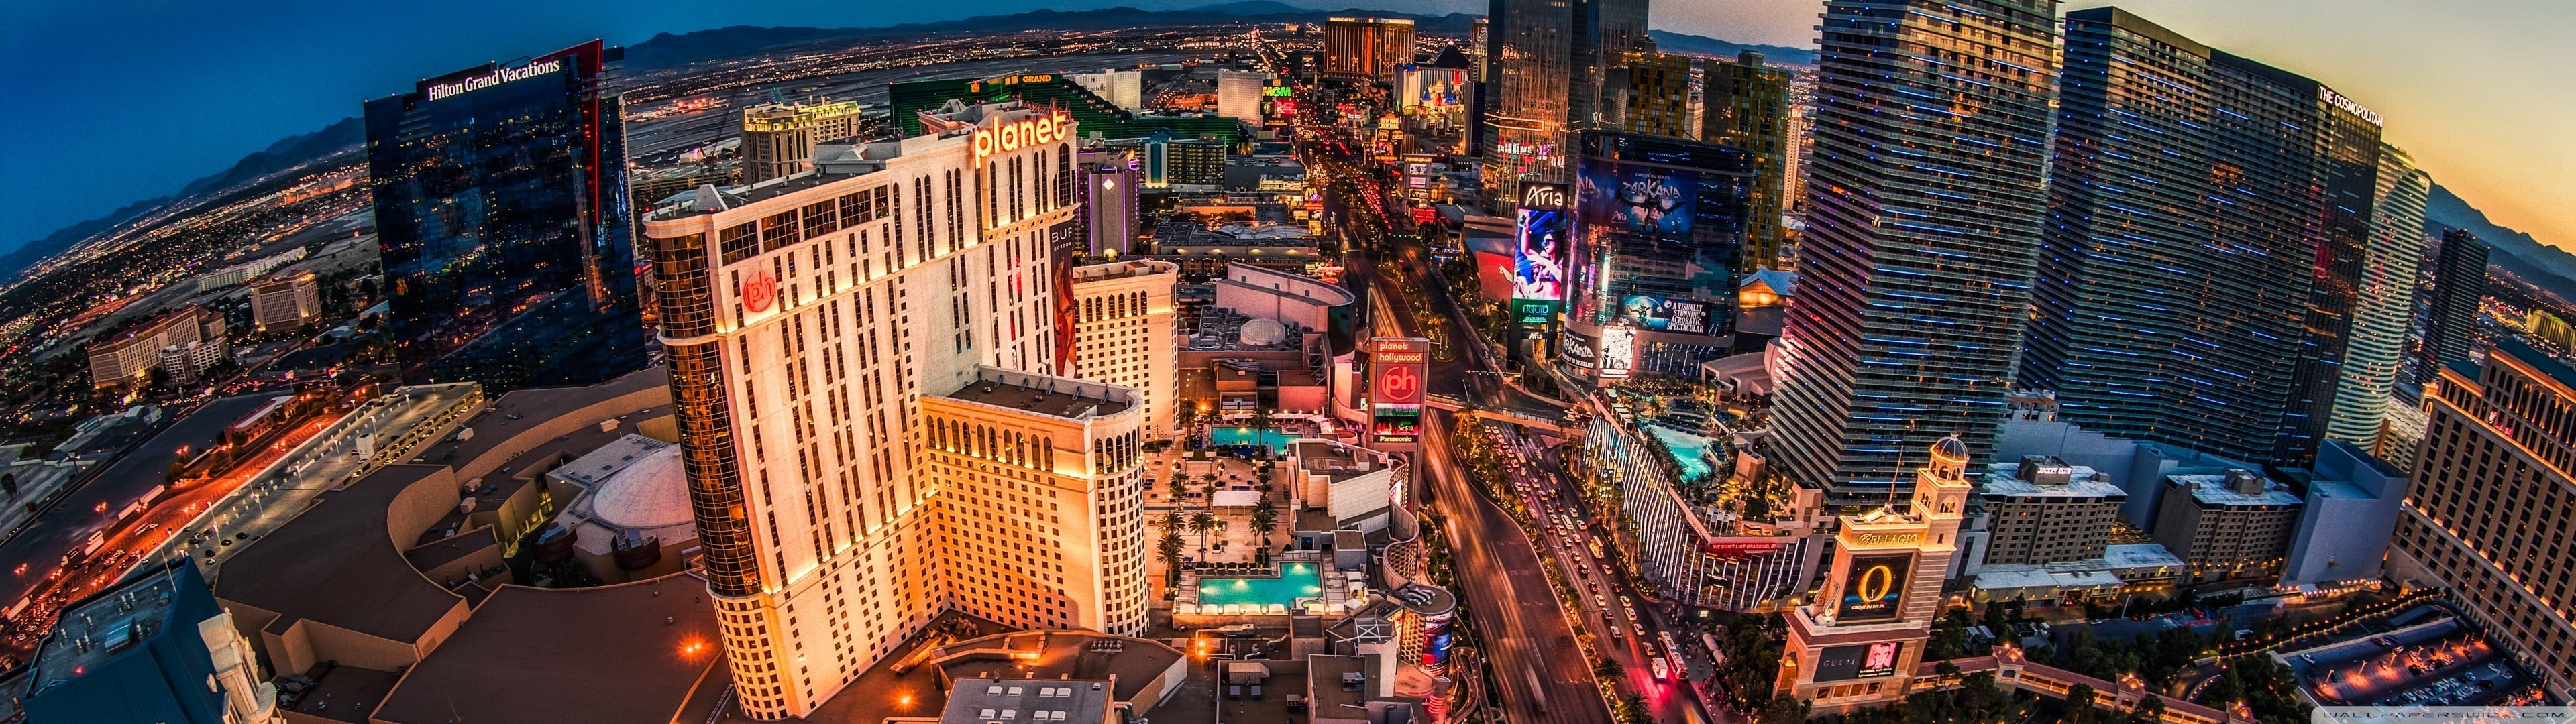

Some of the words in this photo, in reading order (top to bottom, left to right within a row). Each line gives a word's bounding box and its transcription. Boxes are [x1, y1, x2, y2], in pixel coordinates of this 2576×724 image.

[429, 83, 464, 101] Hilton
[464, 70, 500, 92] Grand
[501, 60, 560, 83] Vacations
[1022, 74, 1051, 83] GRAND
[1262, 86, 1291, 97] MGM
[2319, 86, 2334, 104] THE
[2334, 94, 2383, 128] COSMOPOLITAN
[975, 109, 1066, 169] planet
[1620, 179, 1682, 199] ZARKANA
[1525, 186, 1563, 206] Aria
[1611, 210, 1627, 221] Aria
[1523, 304, 1549, 313] LIQUID
[1678, 302, 1703, 312] VISUALLY
[1673, 309, 1700, 318] STUNNING
[1671, 316, 1701, 326] ACROBATIC
[1666, 322, 1704, 333] SPECTACULAR
[1529, 332, 1543, 340] Aria
[1380, 341, 1408, 351] planet
[1379, 352, 1421, 363] hollywood
[1383, 367, 1416, 396] ph
[2037, 467, 2059, 475] JOCKEY
[1858, 565, 1892, 603] O
[1823, 658, 1856, 667] GUCI
